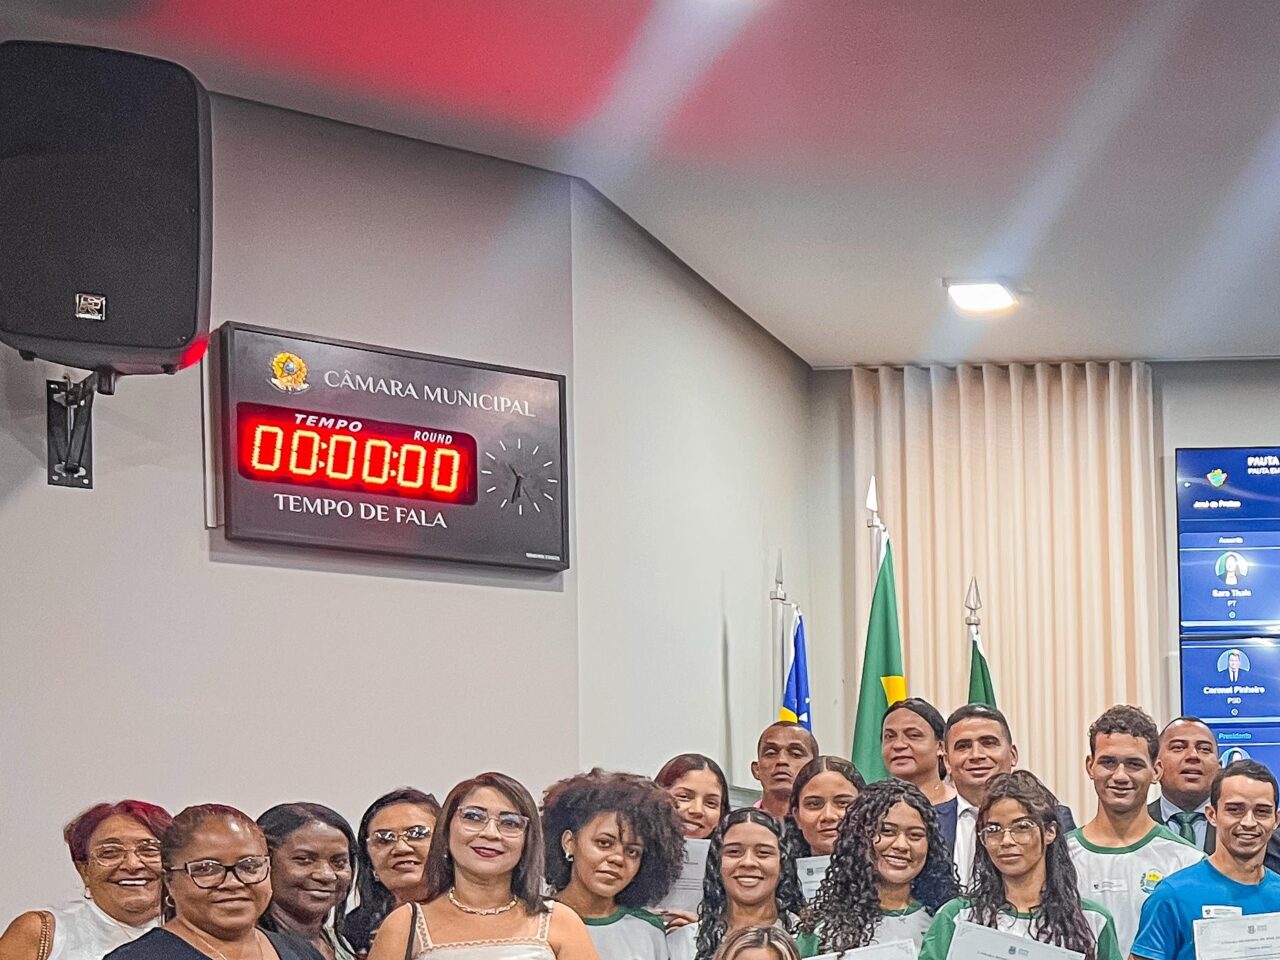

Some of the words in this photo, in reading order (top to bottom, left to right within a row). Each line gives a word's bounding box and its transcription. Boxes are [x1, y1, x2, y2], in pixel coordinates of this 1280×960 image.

[324, 370, 419, 400] CÂMARA
[423, 385, 536, 418] MUNICIPAL
[294, 413, 363, 432] TEMPO
[413, 430, 453, 445] ROUND
[251, 424, 460, 493] 00:00:00
[1248, 456, 1279, 466] PAUTA
[274, 493, 354, 518] TEMPO
[360, 502, 389, 522] DE
[396, 507, 448, 528] FALA
